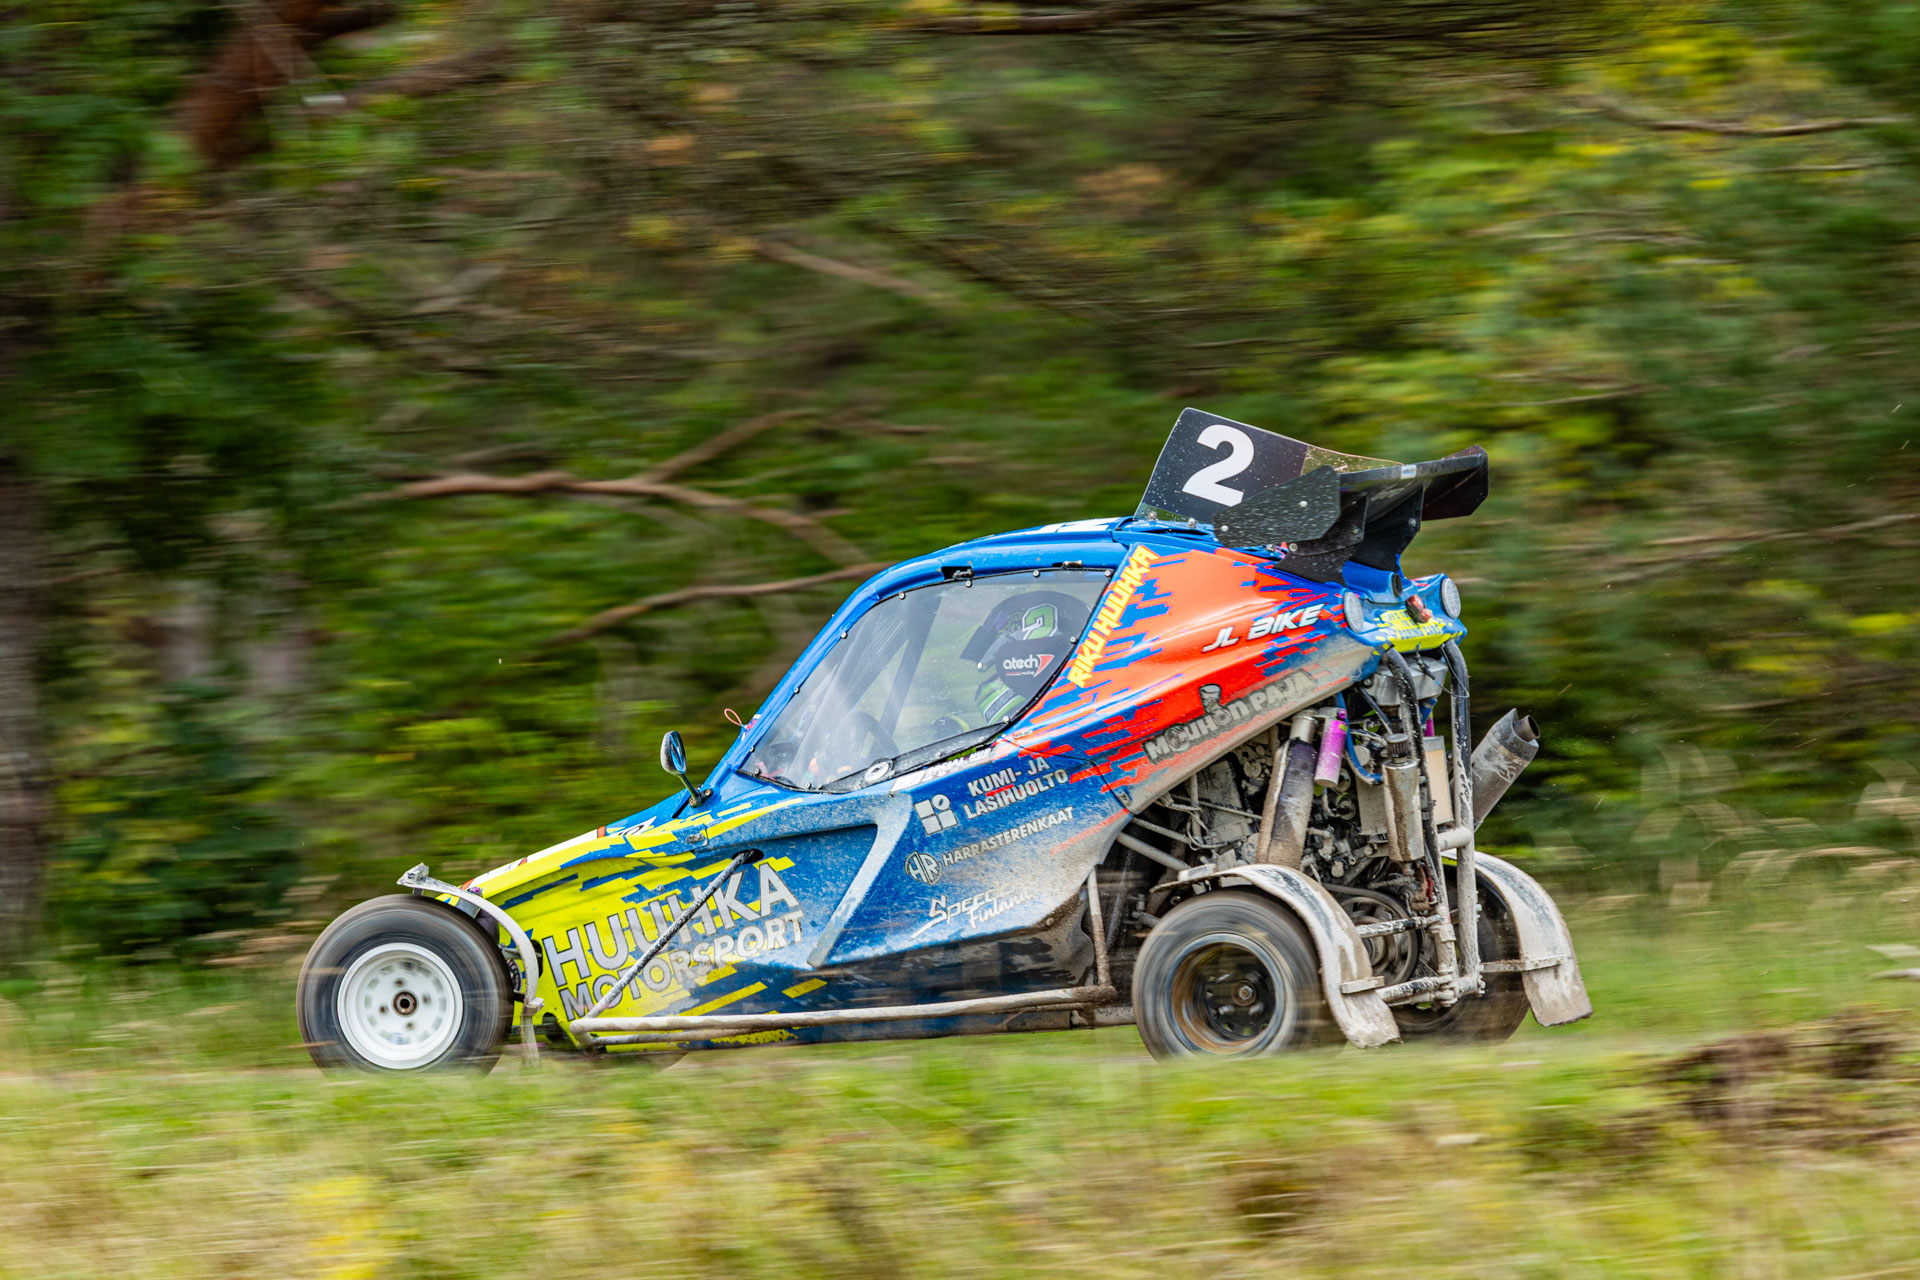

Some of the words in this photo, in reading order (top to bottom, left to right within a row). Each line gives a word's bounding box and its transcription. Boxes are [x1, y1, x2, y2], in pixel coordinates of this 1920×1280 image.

[1182, 424, 1254, 507] 2
[1067, 630, 1106, 688] RIKU
[1092, 545, 1160, 636] HUUHKA
[1202, 626, 1239, 653] JL
[1247, 603, 1326, 641] BIKE
[1003, 654, 1039, 670] atech
[1250, 671, 1318, 712] PAJA
[962, 769, 1069, 820] LASIHUOLTO
[967, 767, 1022, 797] KUMI-
[1027, 756, 1051, 776] JA
[905, 851, 942, 886] HR
[941, 805, 1074, 867] HARRASTERENKAAT
[541, 862, 800, 988] HUUHKA
[557, 910, 805, 1023] MOTORSPORT
